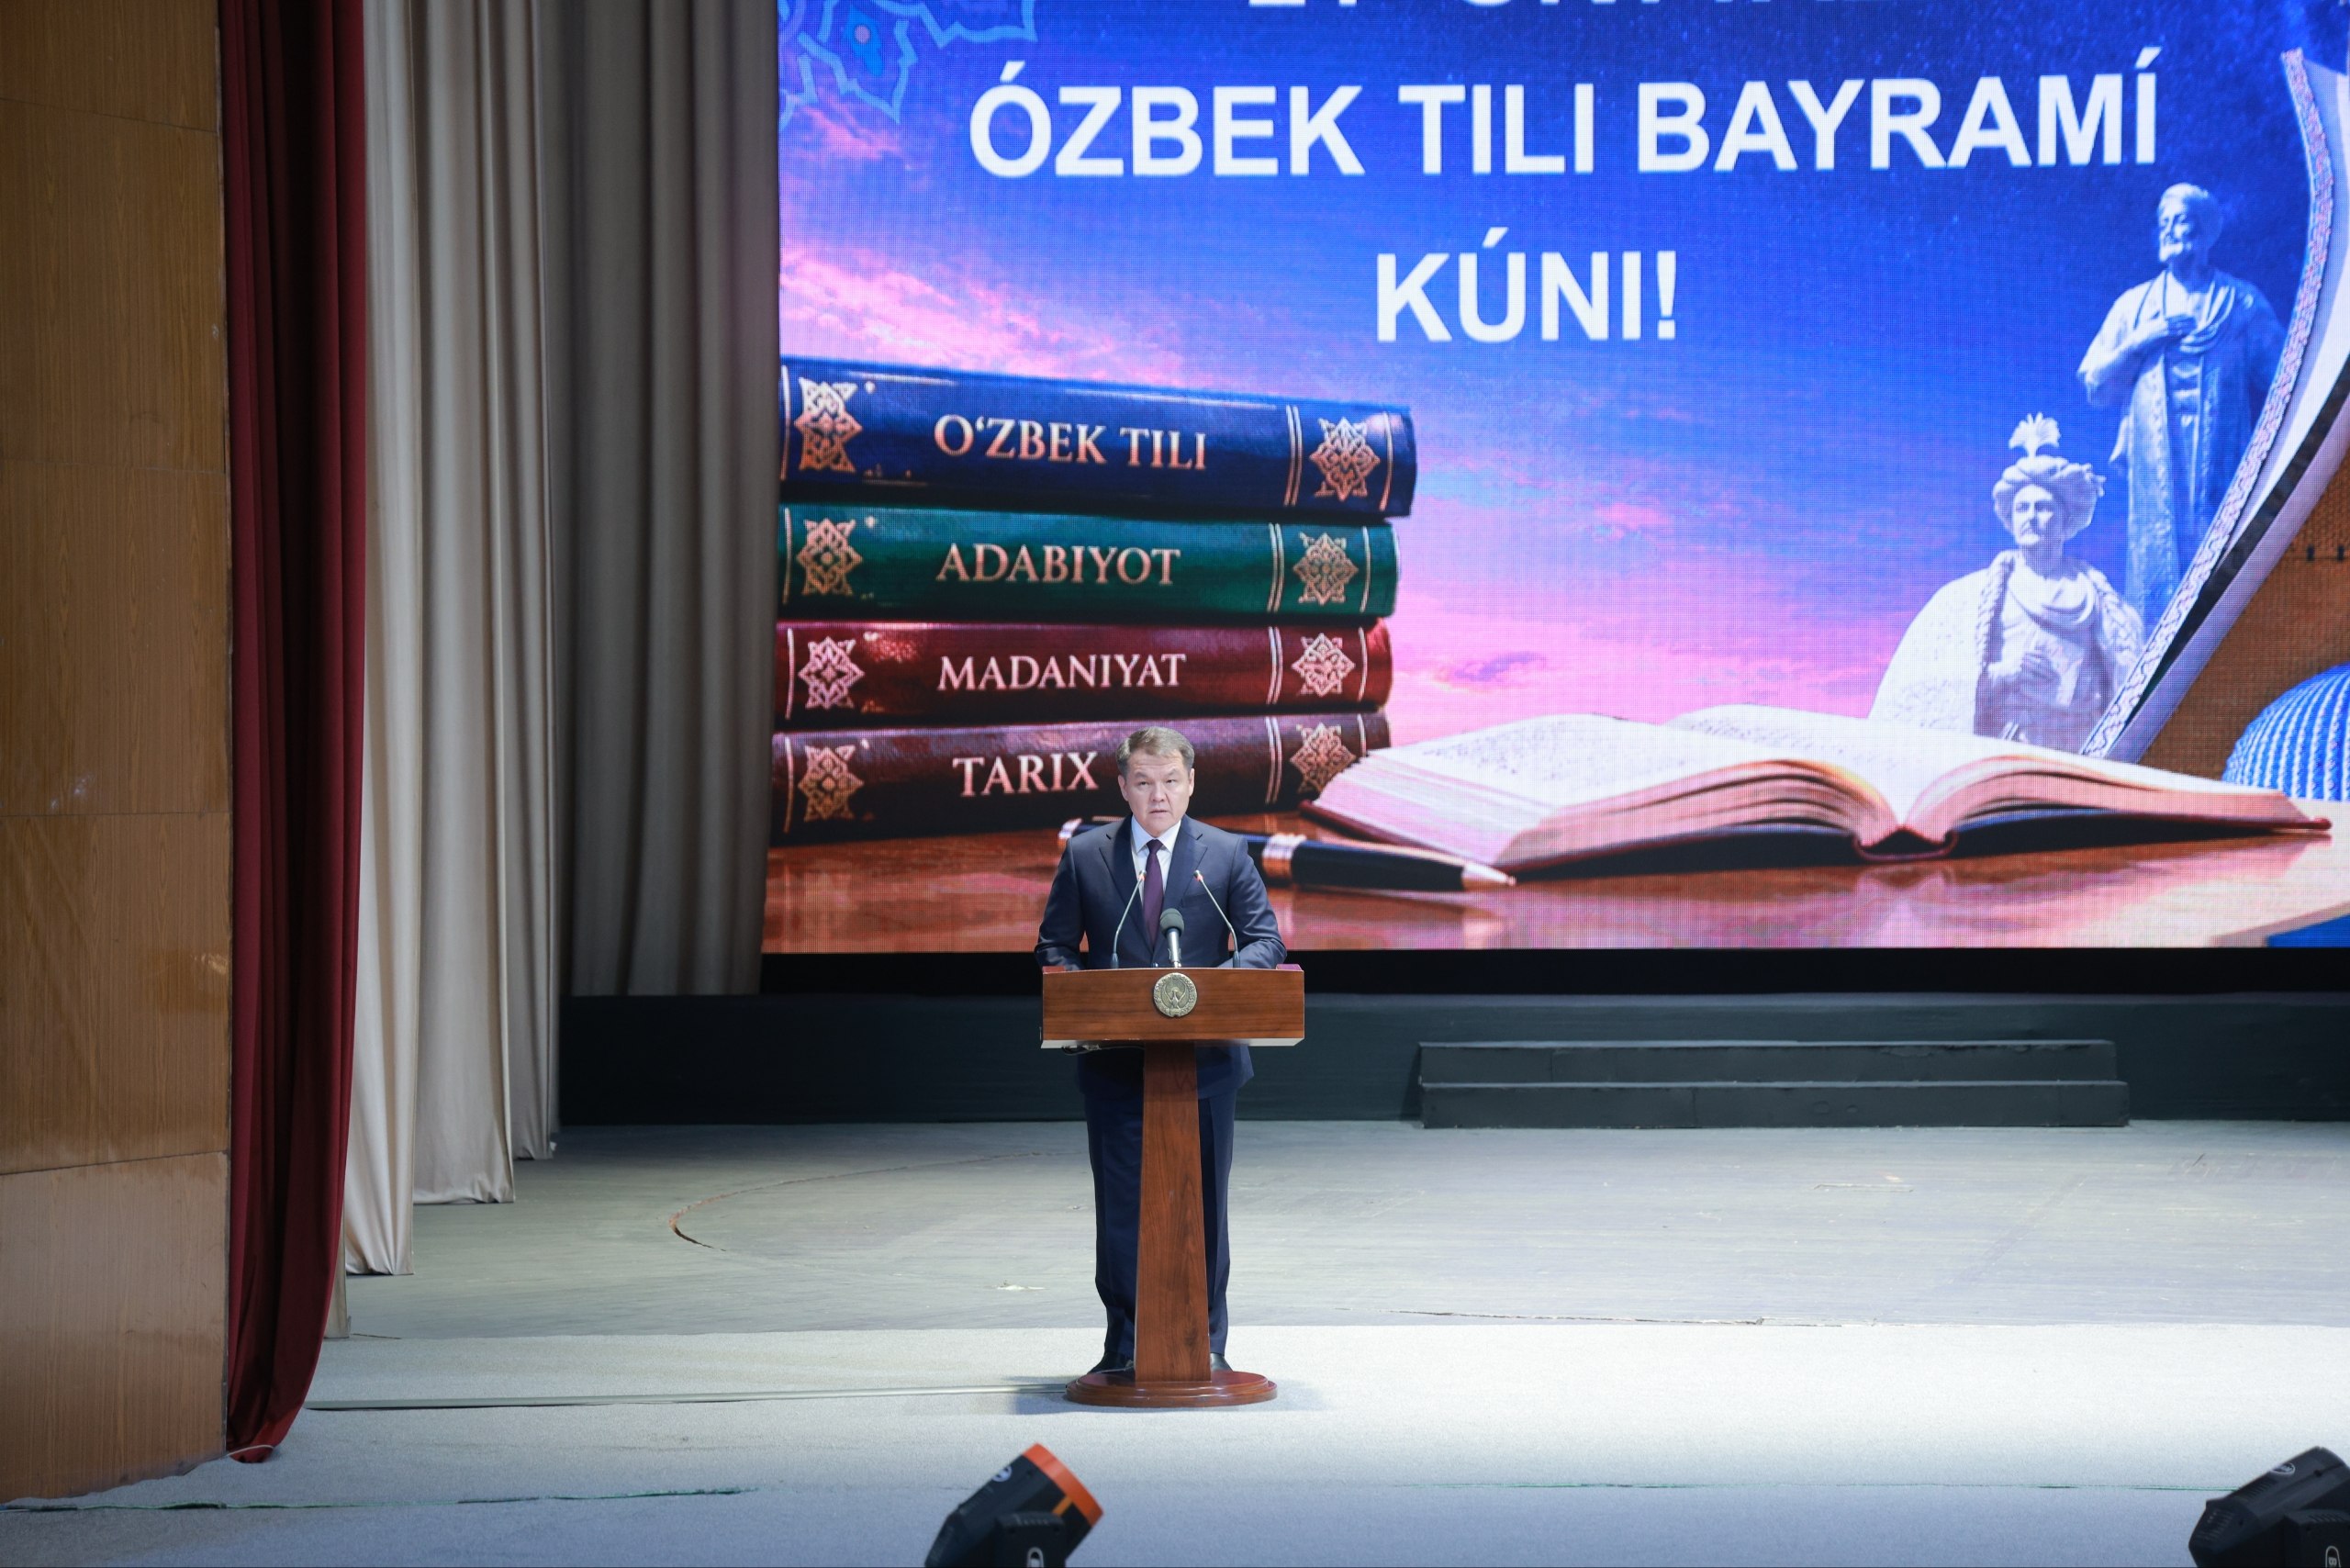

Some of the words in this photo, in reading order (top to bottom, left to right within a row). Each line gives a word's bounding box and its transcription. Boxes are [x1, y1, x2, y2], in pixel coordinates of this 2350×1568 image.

[968, 61, 1366, 178] ÓZBEK
[1398, 84, 1595, 174] TILI
[1638, 47, 2161, 173] BAYRAMÍ
[1376, 227, 1677, 343] KÚNI!
[1119, 427, 1206, 470] TILI
[935, 543, 1181, 585] ADABIYOT
[936, 654, 1187, 690] MADANIYAT
[952, 751, 1099, 797] TARIX
